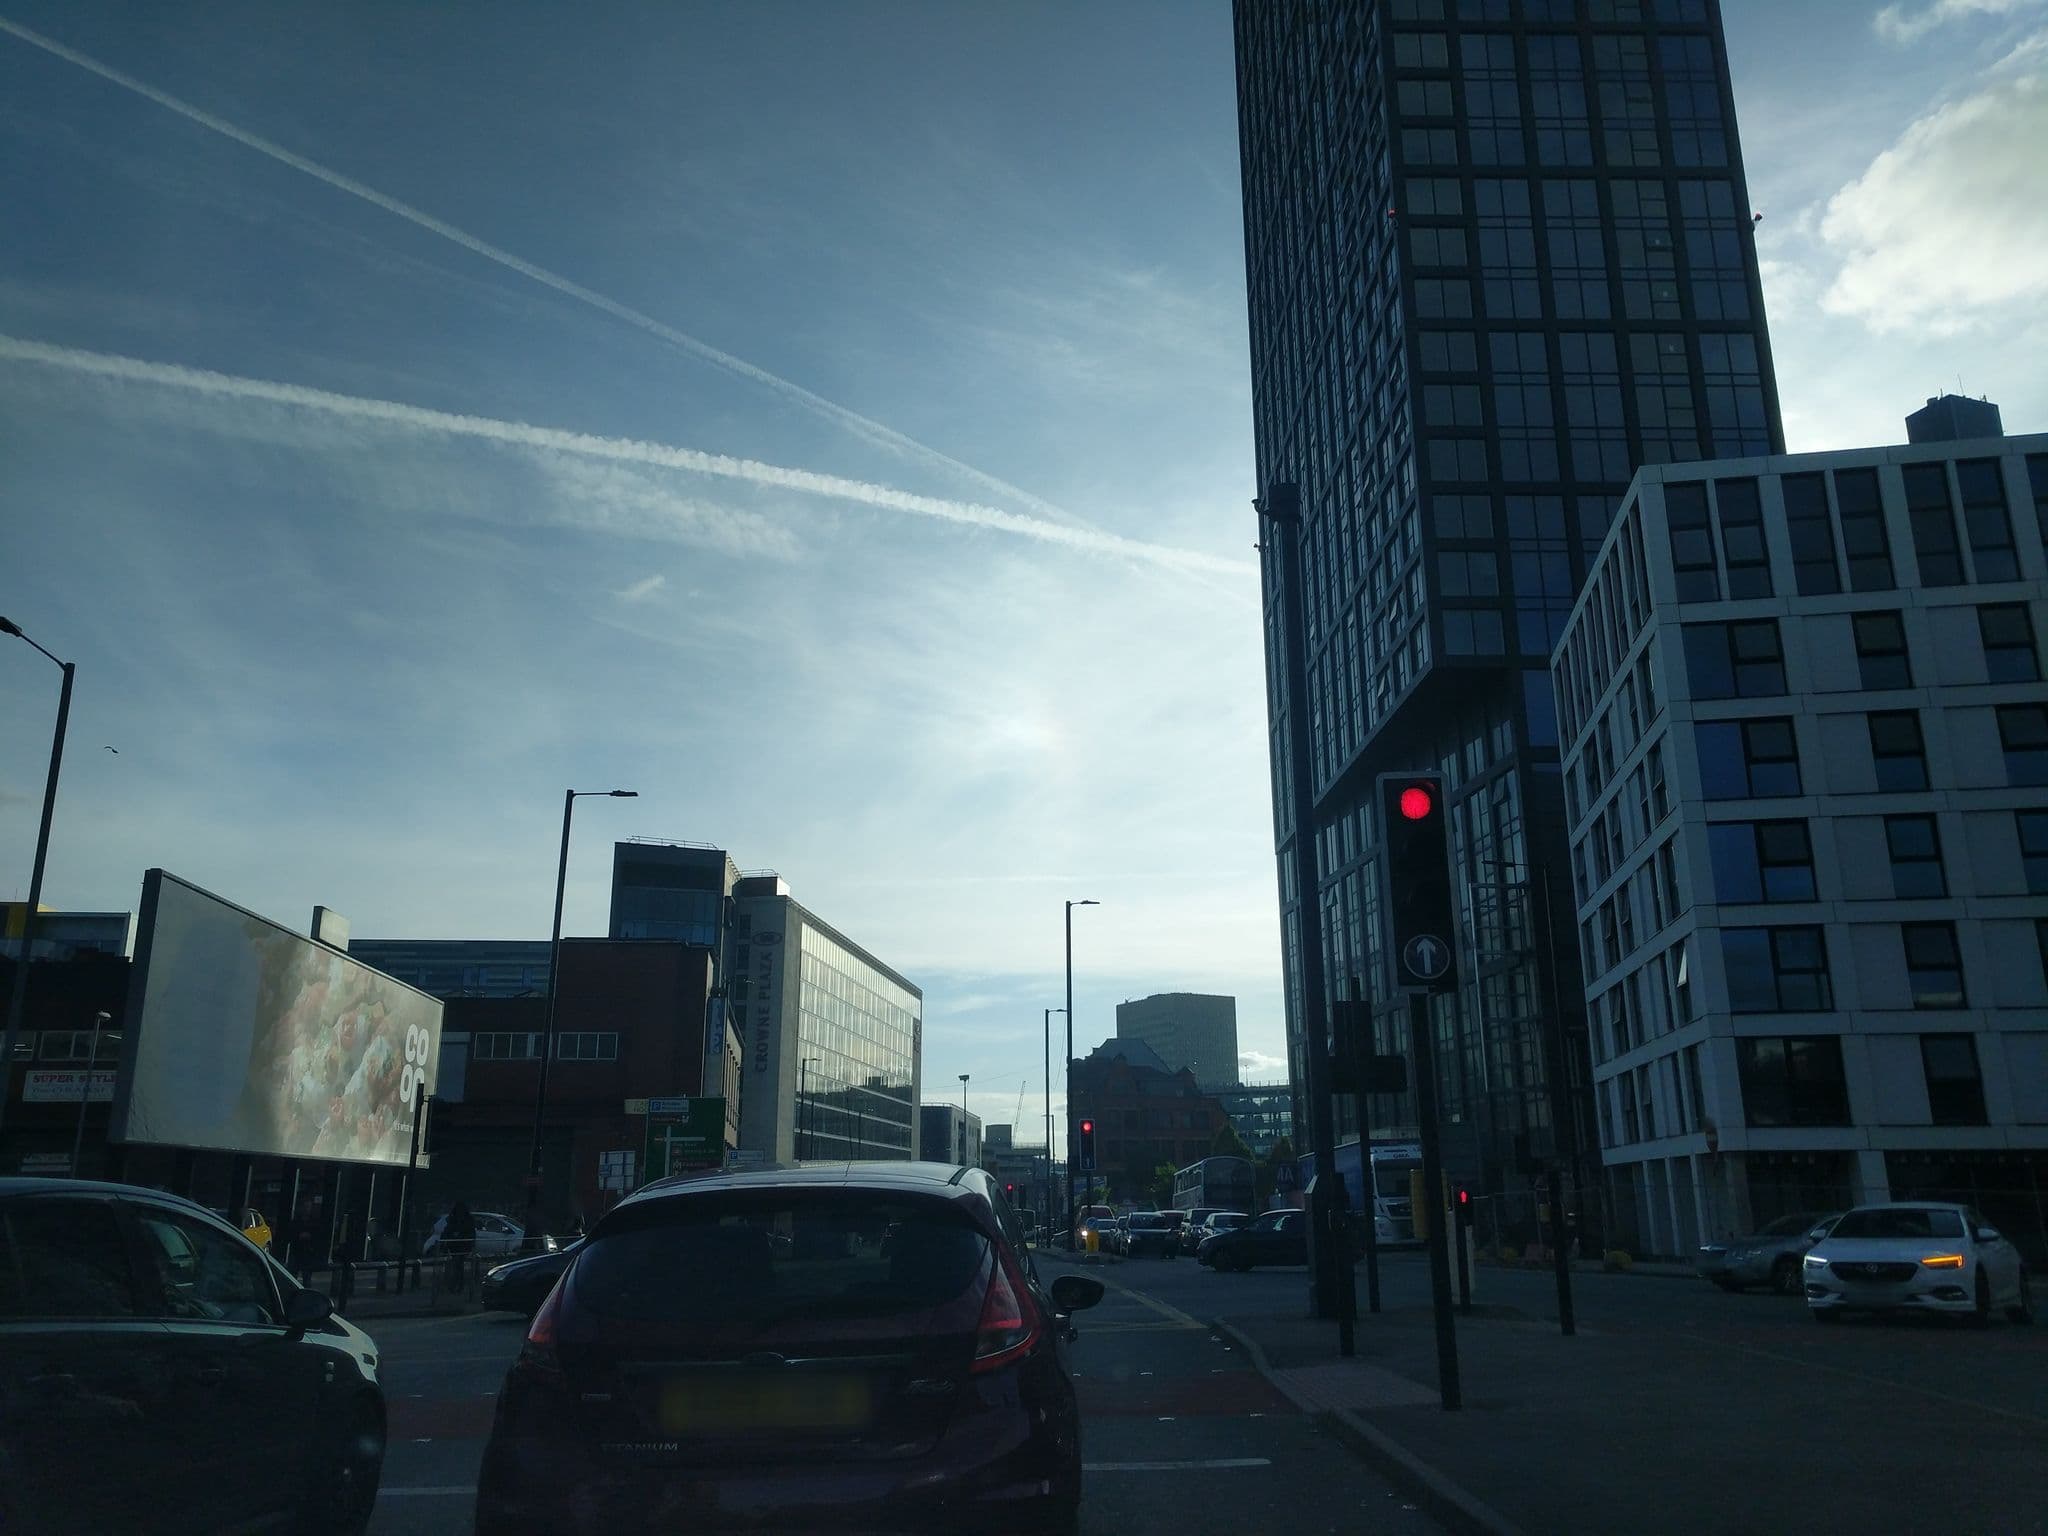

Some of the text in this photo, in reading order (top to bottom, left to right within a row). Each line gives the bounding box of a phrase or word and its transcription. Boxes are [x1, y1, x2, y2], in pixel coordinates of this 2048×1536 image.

[755, 951, 773, 1073] CROWNE PLAZA
[32, 1074, 74, 1083] SUPER
